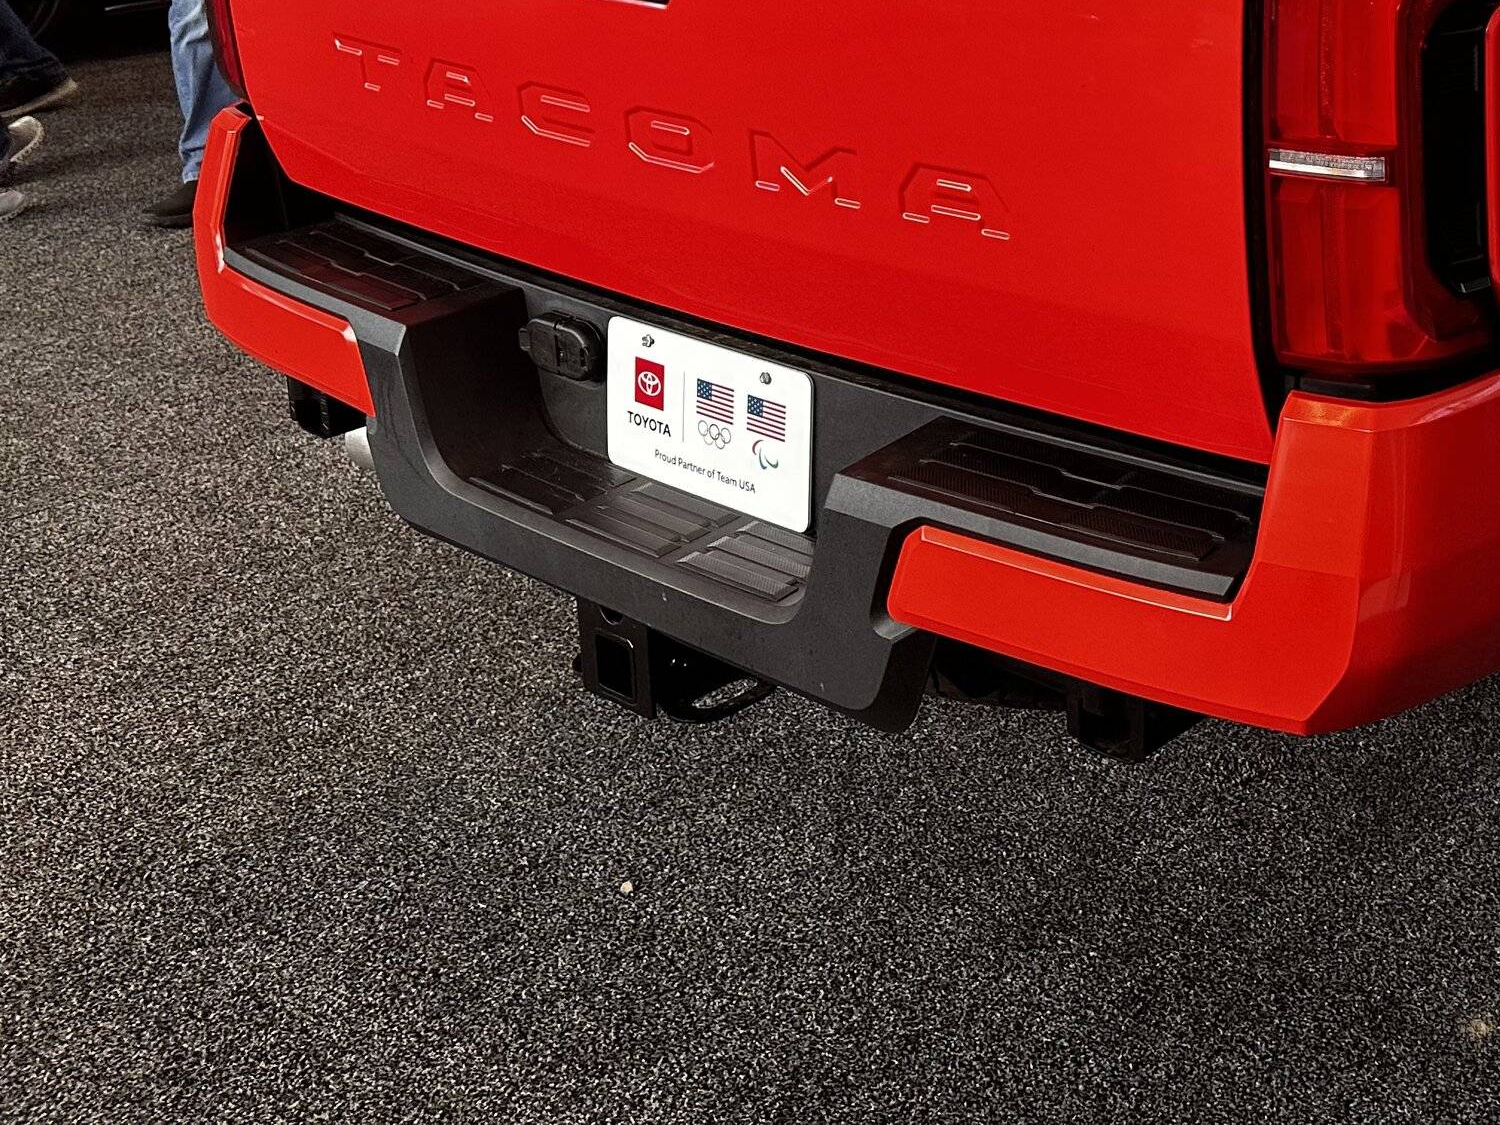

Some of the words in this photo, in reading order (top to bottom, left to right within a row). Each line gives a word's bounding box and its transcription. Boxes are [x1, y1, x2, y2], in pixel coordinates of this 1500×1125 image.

[332, 31, 1011, 240] TACOMA
[627, 410, 671, 437] TOYOTA
[654, 448, 677, 466] Proud
[678, 457, 706, 477] Partner
[707, 469, 716, 480] of
[717, 471, 737, 488] Team
[739, 478, 756, 494] USA
